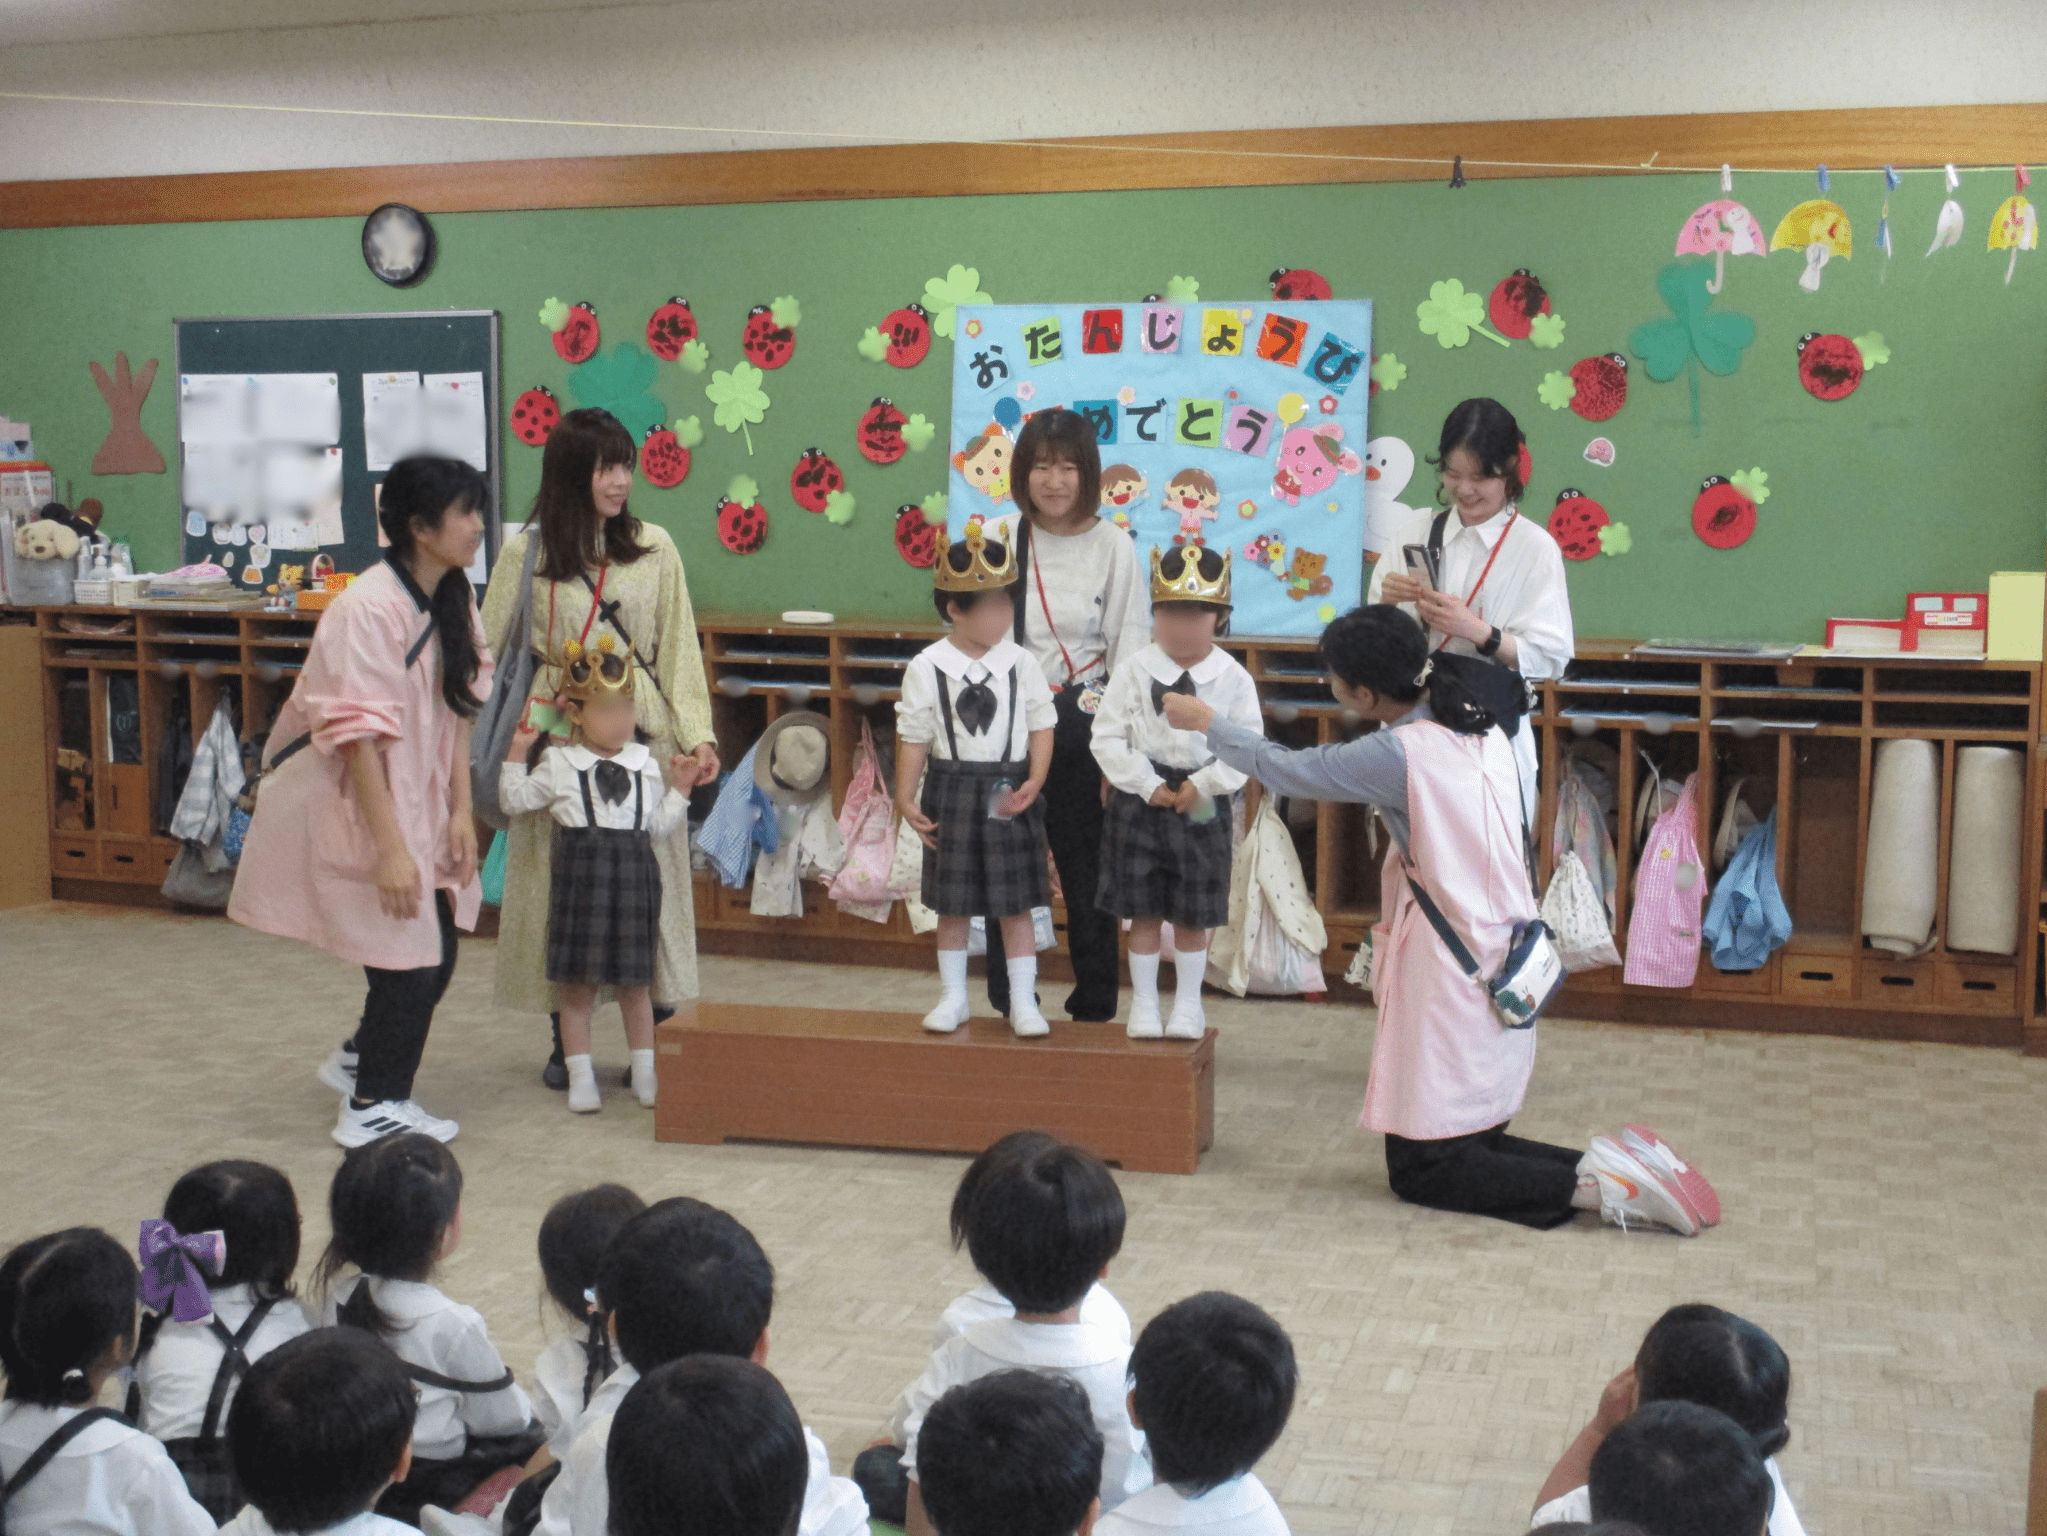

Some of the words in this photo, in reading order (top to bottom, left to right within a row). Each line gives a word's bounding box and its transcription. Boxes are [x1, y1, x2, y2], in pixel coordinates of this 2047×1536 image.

[969, 312, 1361, 389] おたんじょうび
[1082, 398, 1268, 454] めでとう
